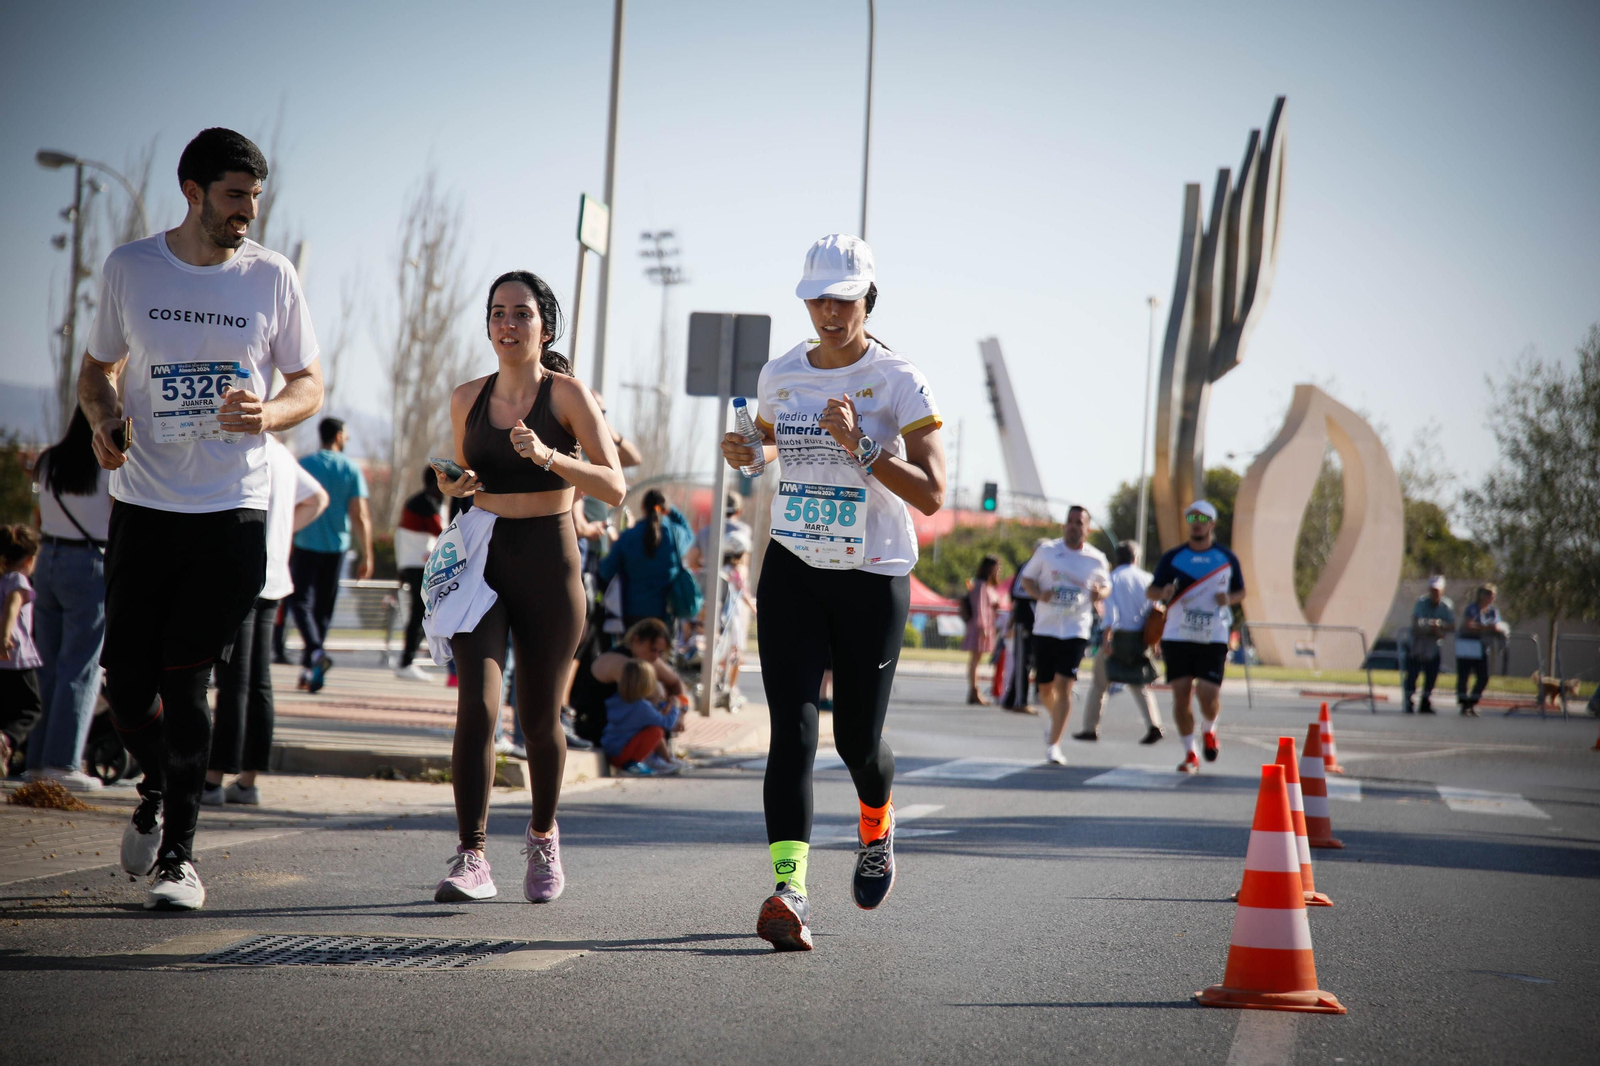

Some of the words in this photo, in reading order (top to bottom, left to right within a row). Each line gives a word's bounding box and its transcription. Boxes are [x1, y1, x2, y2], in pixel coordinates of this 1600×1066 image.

[149, 308, 247, 328] COSENTINO
[162, 375, 232, 401] 5326
[181, 399, 213, 407] JUANFRA
[777, 412, 807, 422] Medio
[776, 423, 822, 435] Almería
[784, 497, 857, 527] 5698
[804, 523, 829, 532] MARTA
